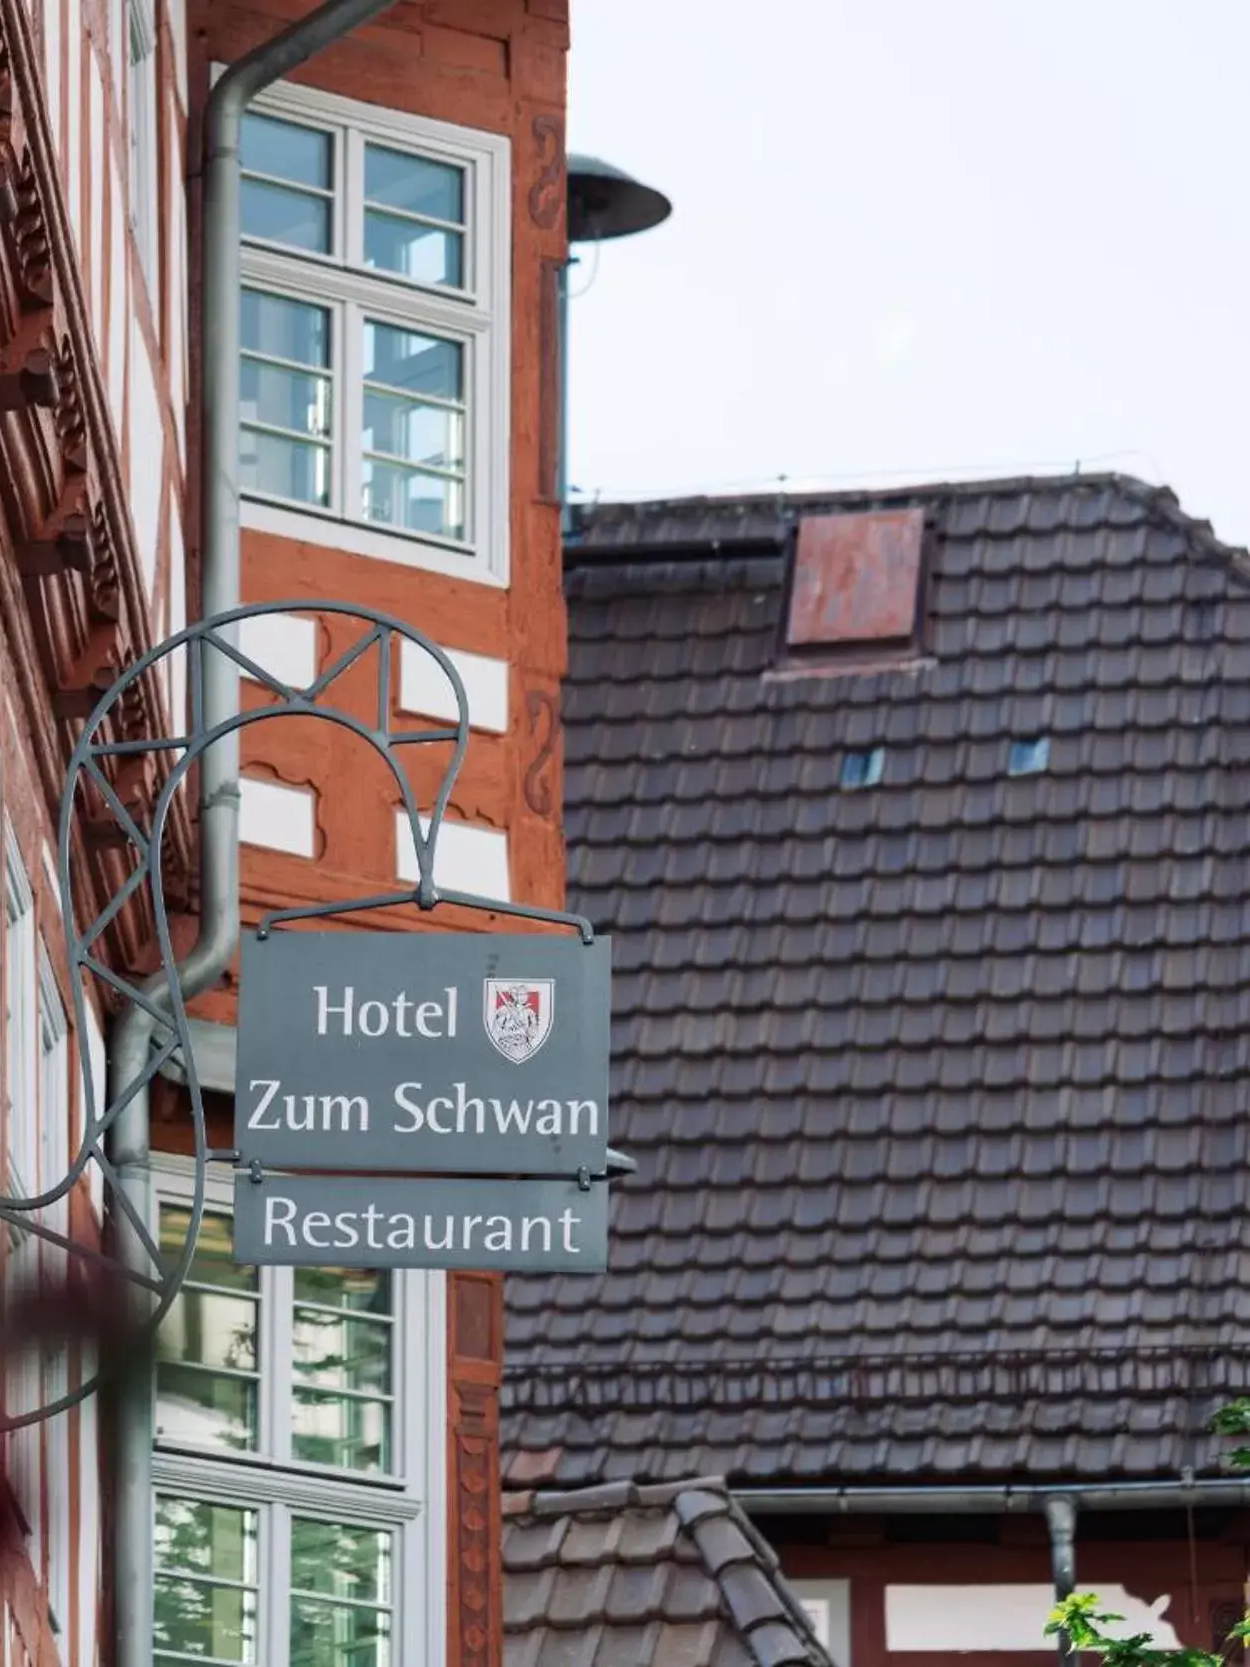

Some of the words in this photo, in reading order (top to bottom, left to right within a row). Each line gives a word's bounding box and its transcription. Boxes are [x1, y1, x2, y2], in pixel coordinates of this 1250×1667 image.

[313, 986, 458, 1038] Hotel
[247, 1079, 369, 1131] Zum
[393, 1082, 599, 1136] Schwan
[263, 1197, 582, 1253] Restaurant
